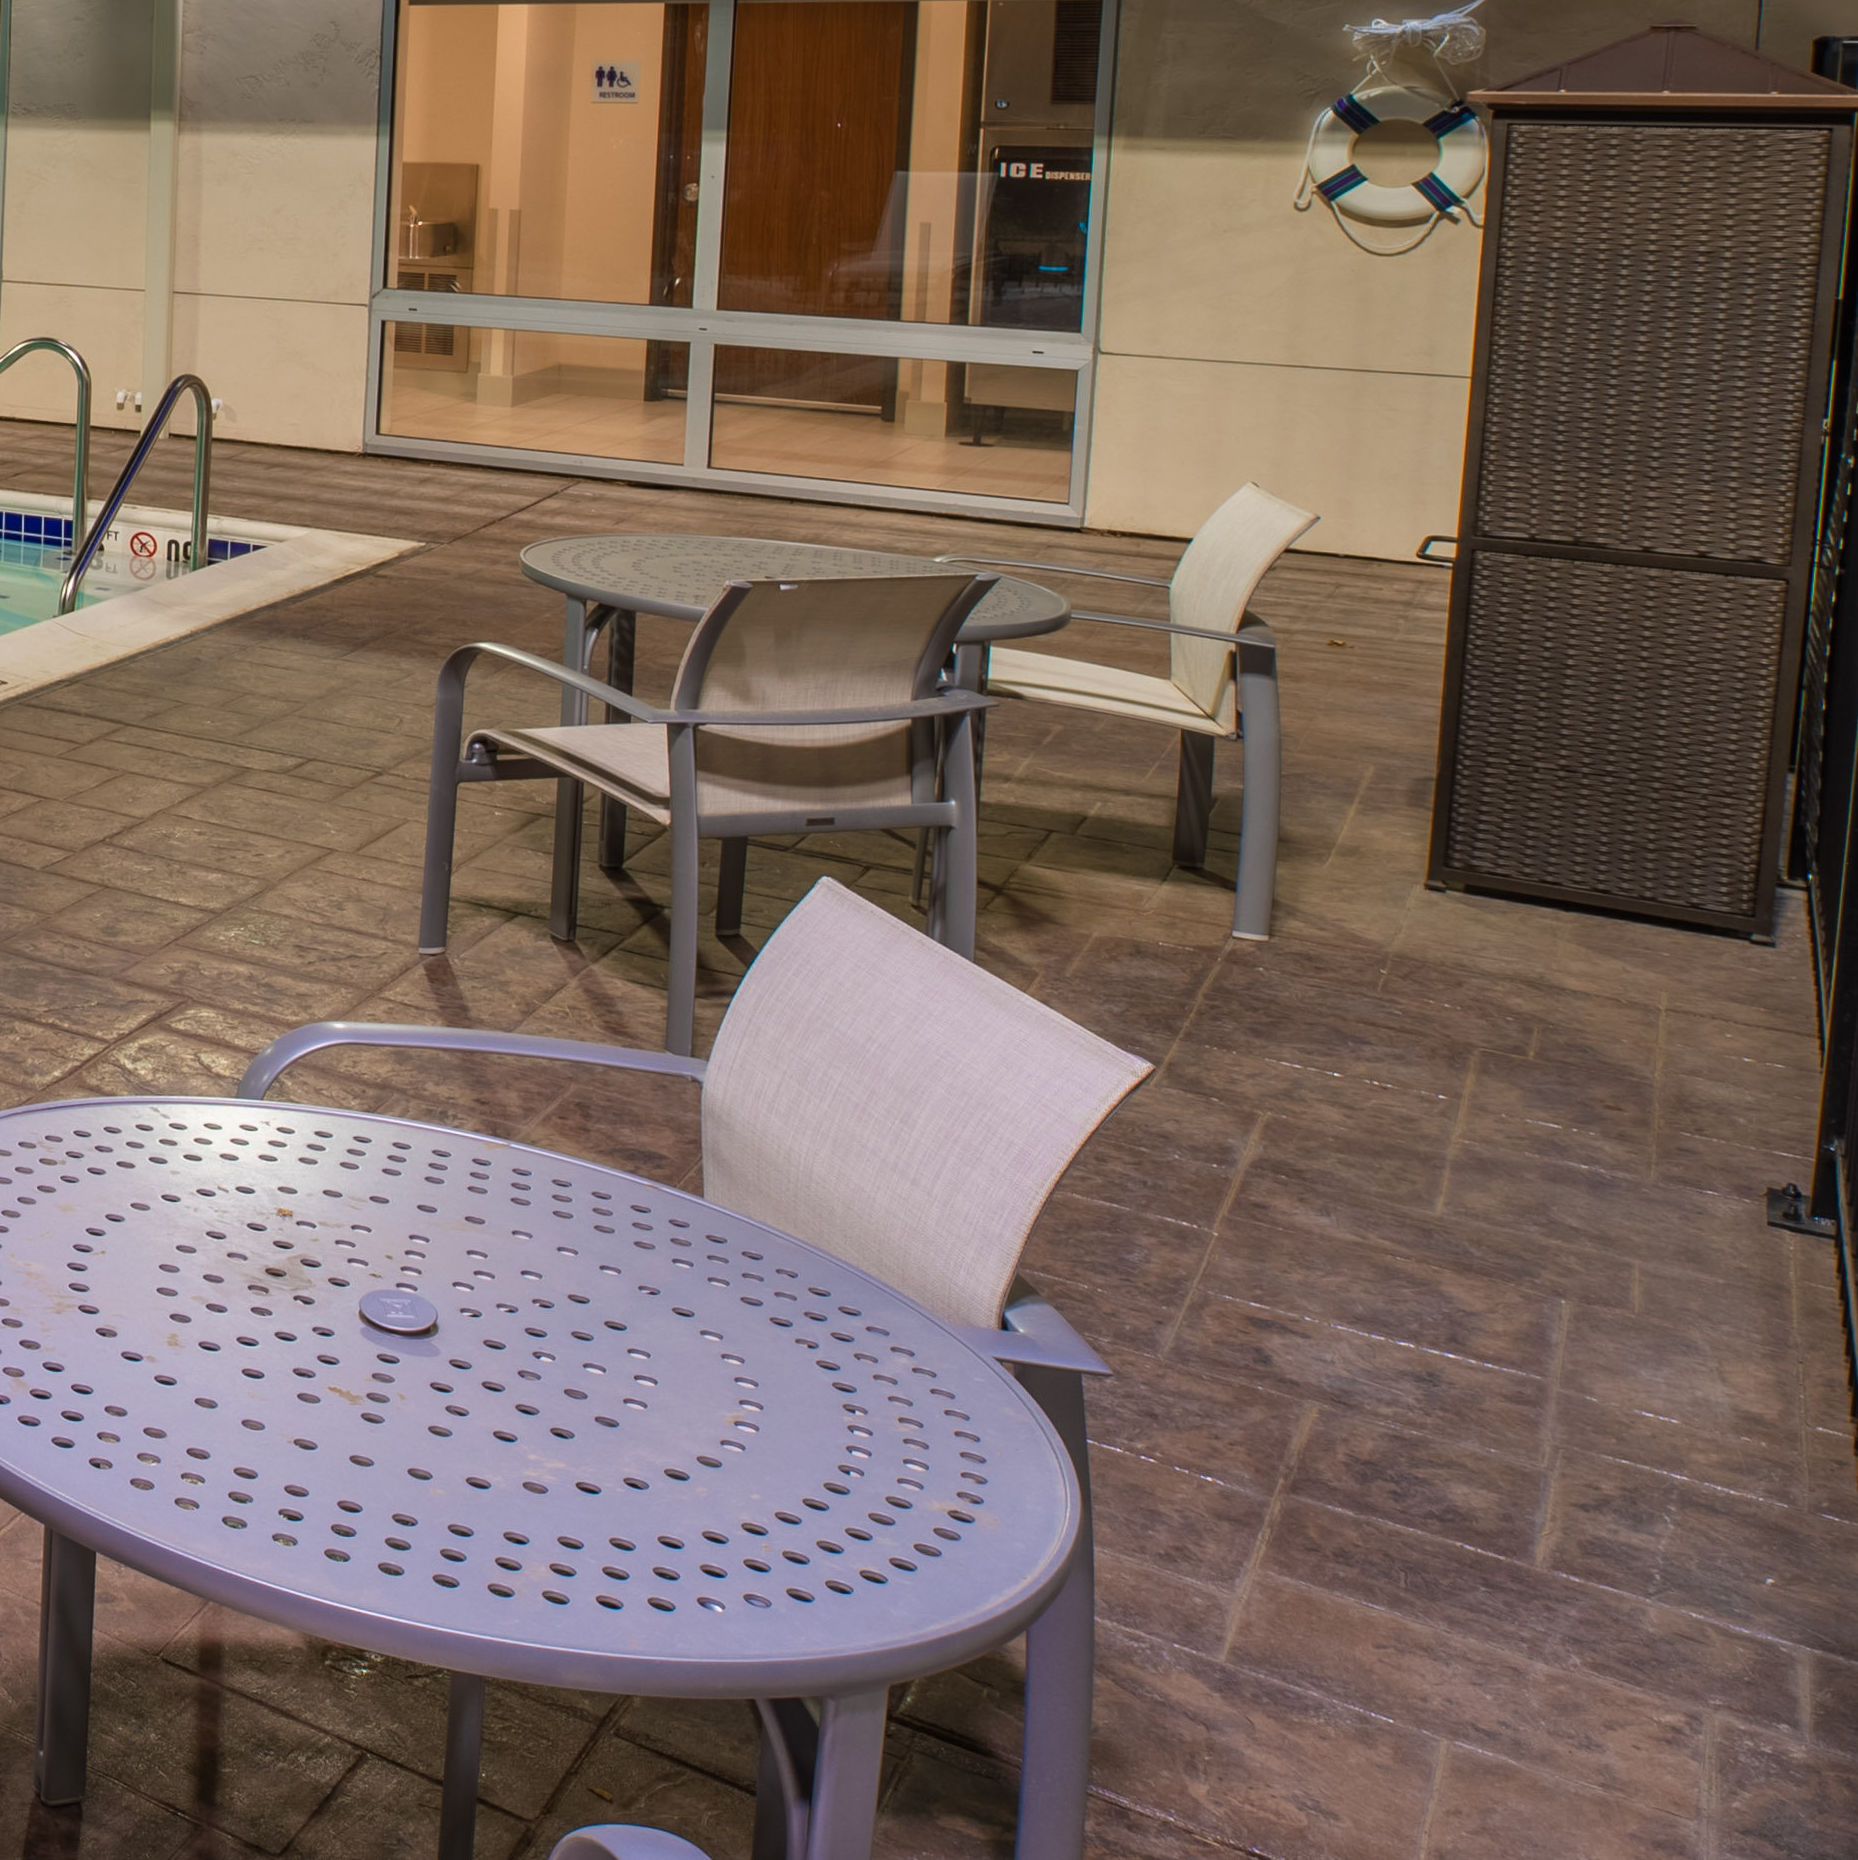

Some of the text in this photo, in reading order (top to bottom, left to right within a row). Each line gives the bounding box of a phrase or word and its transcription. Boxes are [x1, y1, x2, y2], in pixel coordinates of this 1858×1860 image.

[999, 162, 1091, 180] ICE DISPENSER
[106, 530, 119, 541] FT
